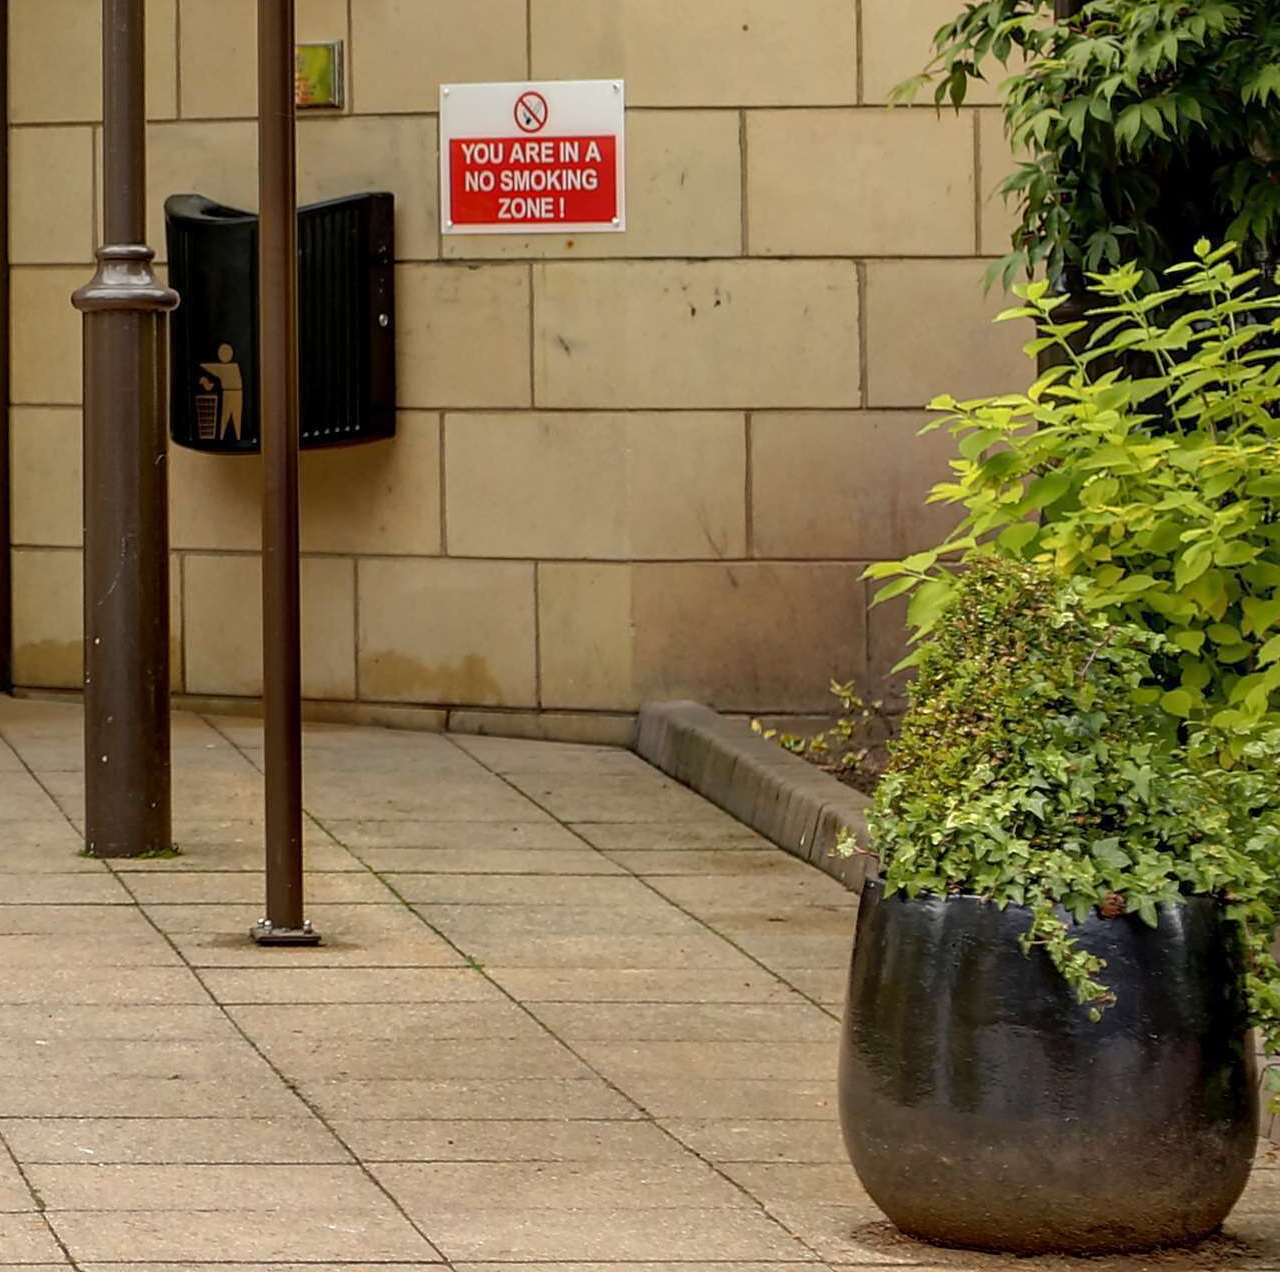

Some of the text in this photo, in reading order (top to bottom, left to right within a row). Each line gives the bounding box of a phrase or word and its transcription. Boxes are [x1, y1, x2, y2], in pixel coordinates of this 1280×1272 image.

[461, 140, 601, 164] YOU ARE IN A
[465, 169, 598, 192] NO SMOKING
[498, 197, 554, 219] ZONE
